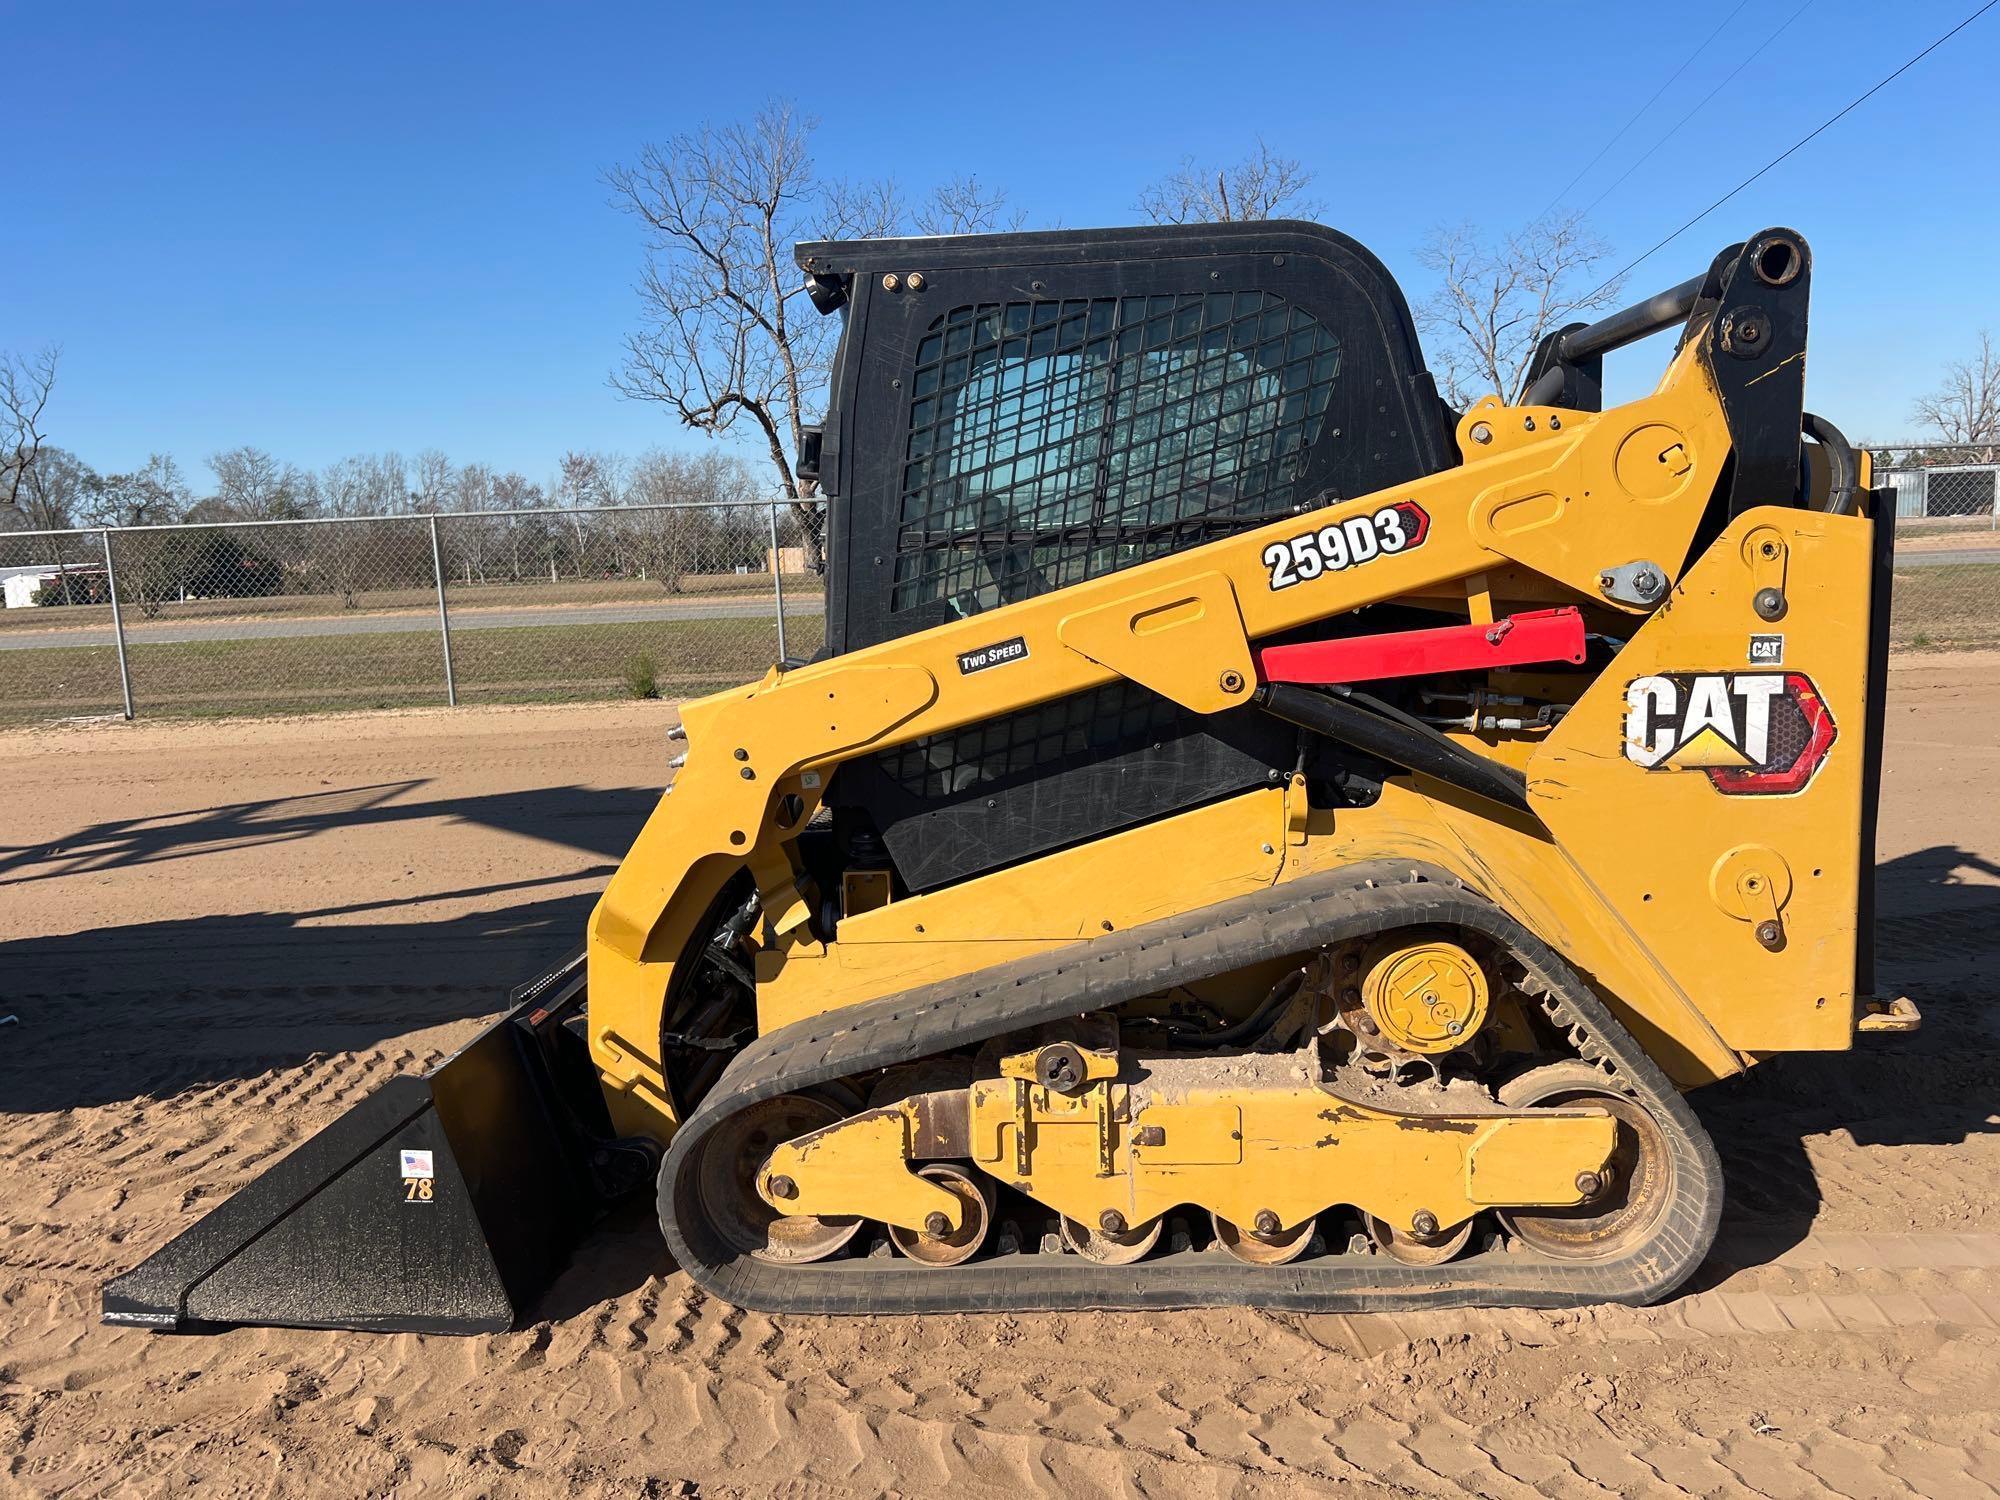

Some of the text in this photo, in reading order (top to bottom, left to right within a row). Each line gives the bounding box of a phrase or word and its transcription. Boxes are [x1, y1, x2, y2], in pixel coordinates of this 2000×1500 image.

[1264, 508, 1406, 589] 259D3
[962, 643, 1022, 670] TWO SPEED
[1752, 641, 1781, 657] CAT
[1626, 675, 1784, 767] CAT
